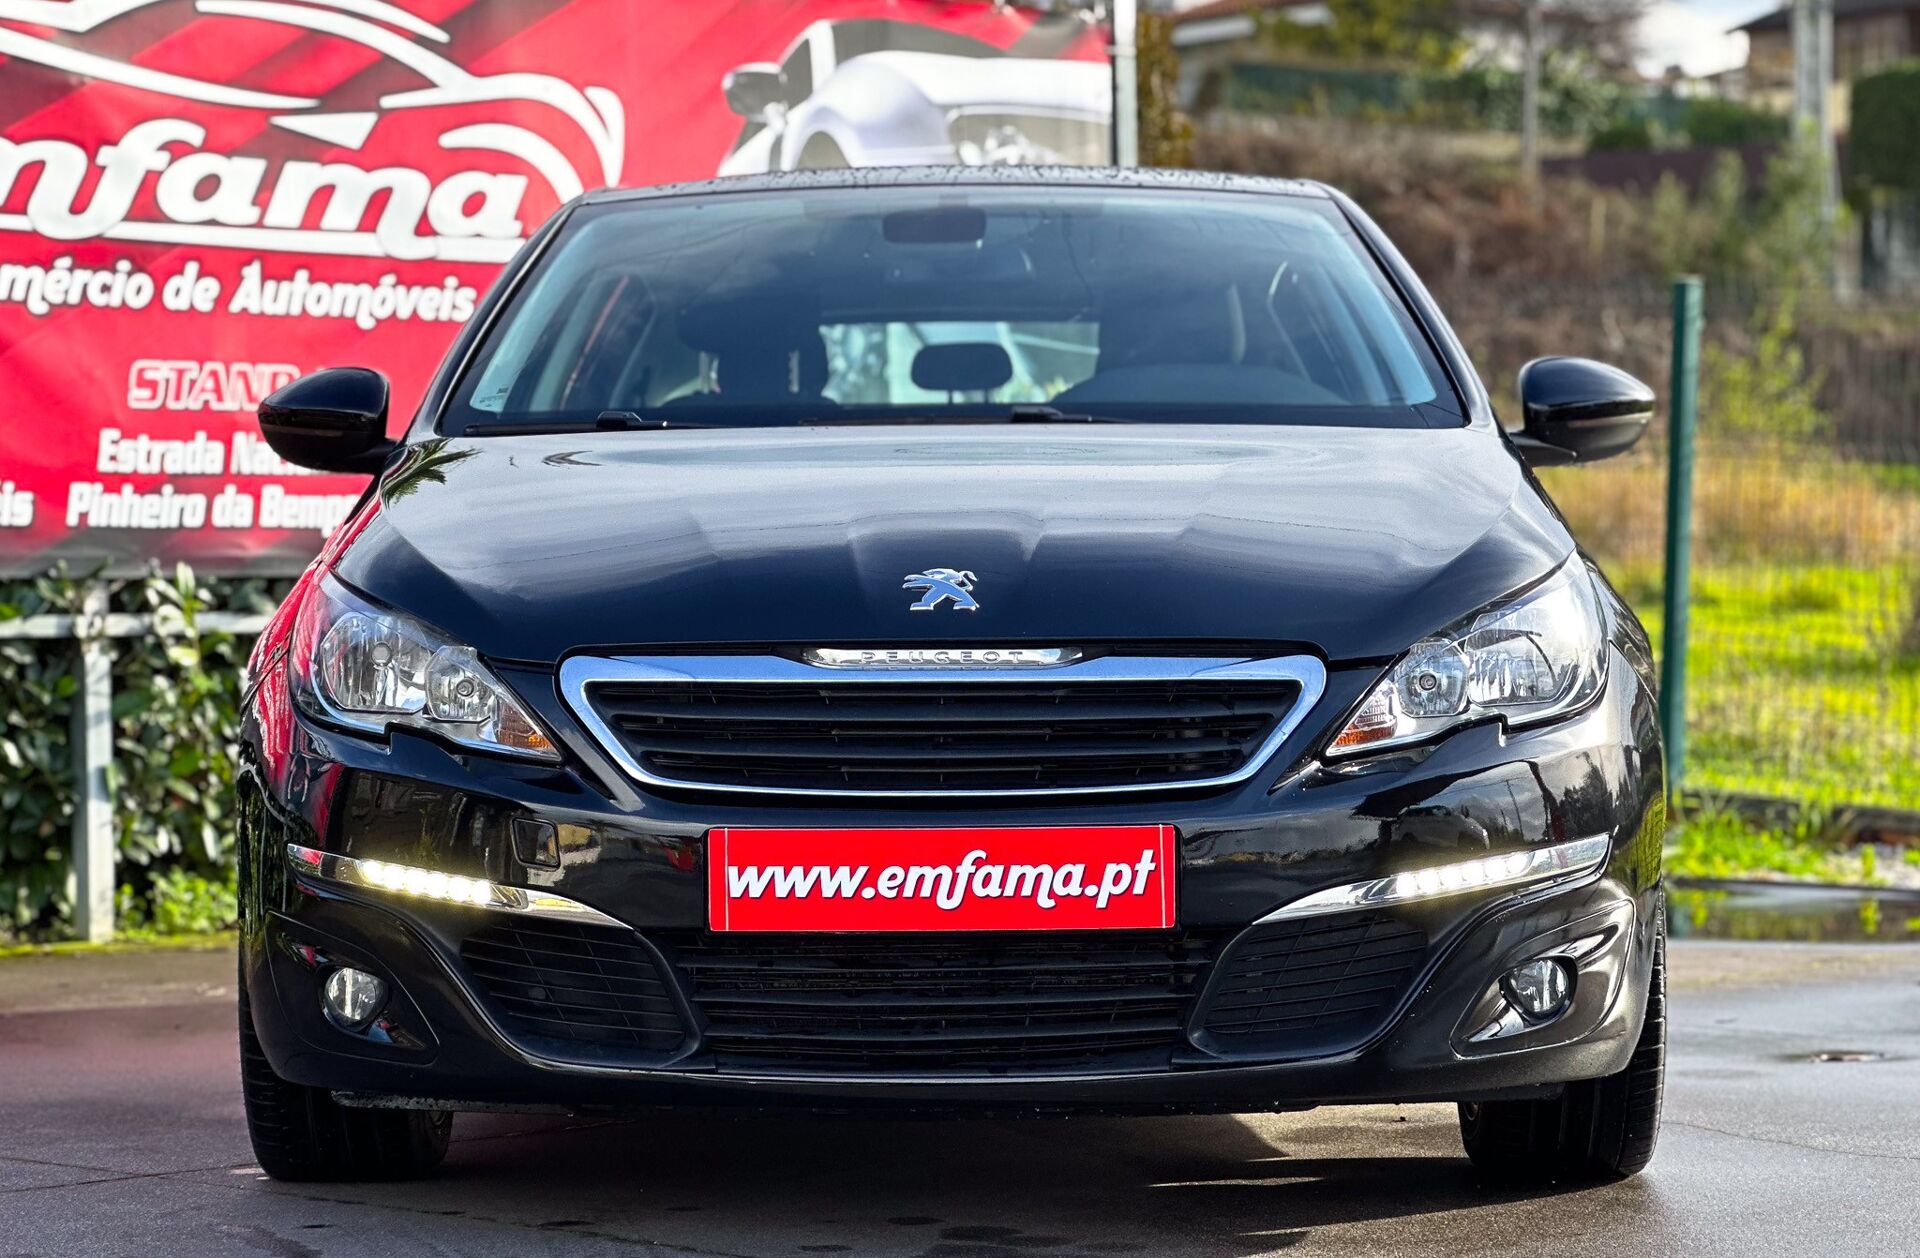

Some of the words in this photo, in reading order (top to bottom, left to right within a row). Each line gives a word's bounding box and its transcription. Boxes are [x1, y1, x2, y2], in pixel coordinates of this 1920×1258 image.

[163, 260, 220, 312] de
[228, 259, 477, 330] Automóveis
[97, 428, 225, 475] Estrada
[66, 482, 207, 528] Pinheiro
[212, 484, 254, 528] da
[860, 651, 1023, 664] PEUGEOT
[727, 849, 1157, 910] www.emfama.pt
